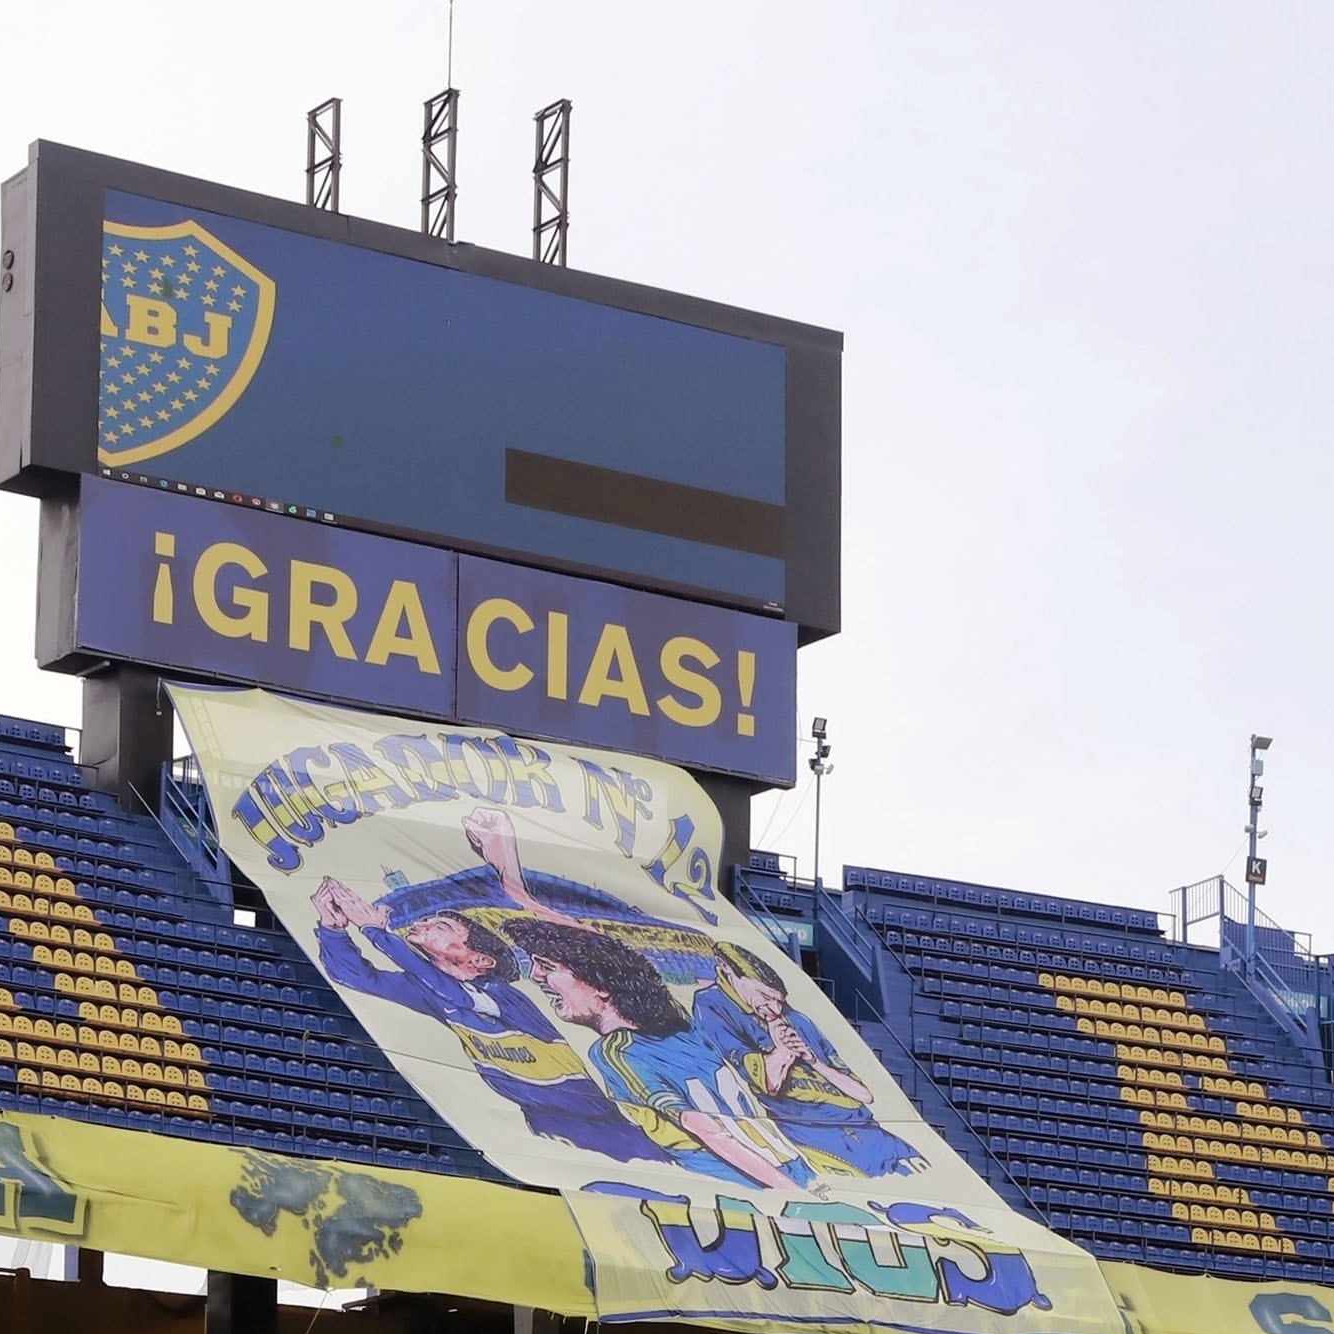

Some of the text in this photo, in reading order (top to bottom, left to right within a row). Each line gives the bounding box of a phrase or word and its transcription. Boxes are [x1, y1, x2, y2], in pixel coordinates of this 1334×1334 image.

[232, 733, 566, 875] JUGADOR
[641, 814, 718, 926] 12
[1251, 860, 1262, 874] K
